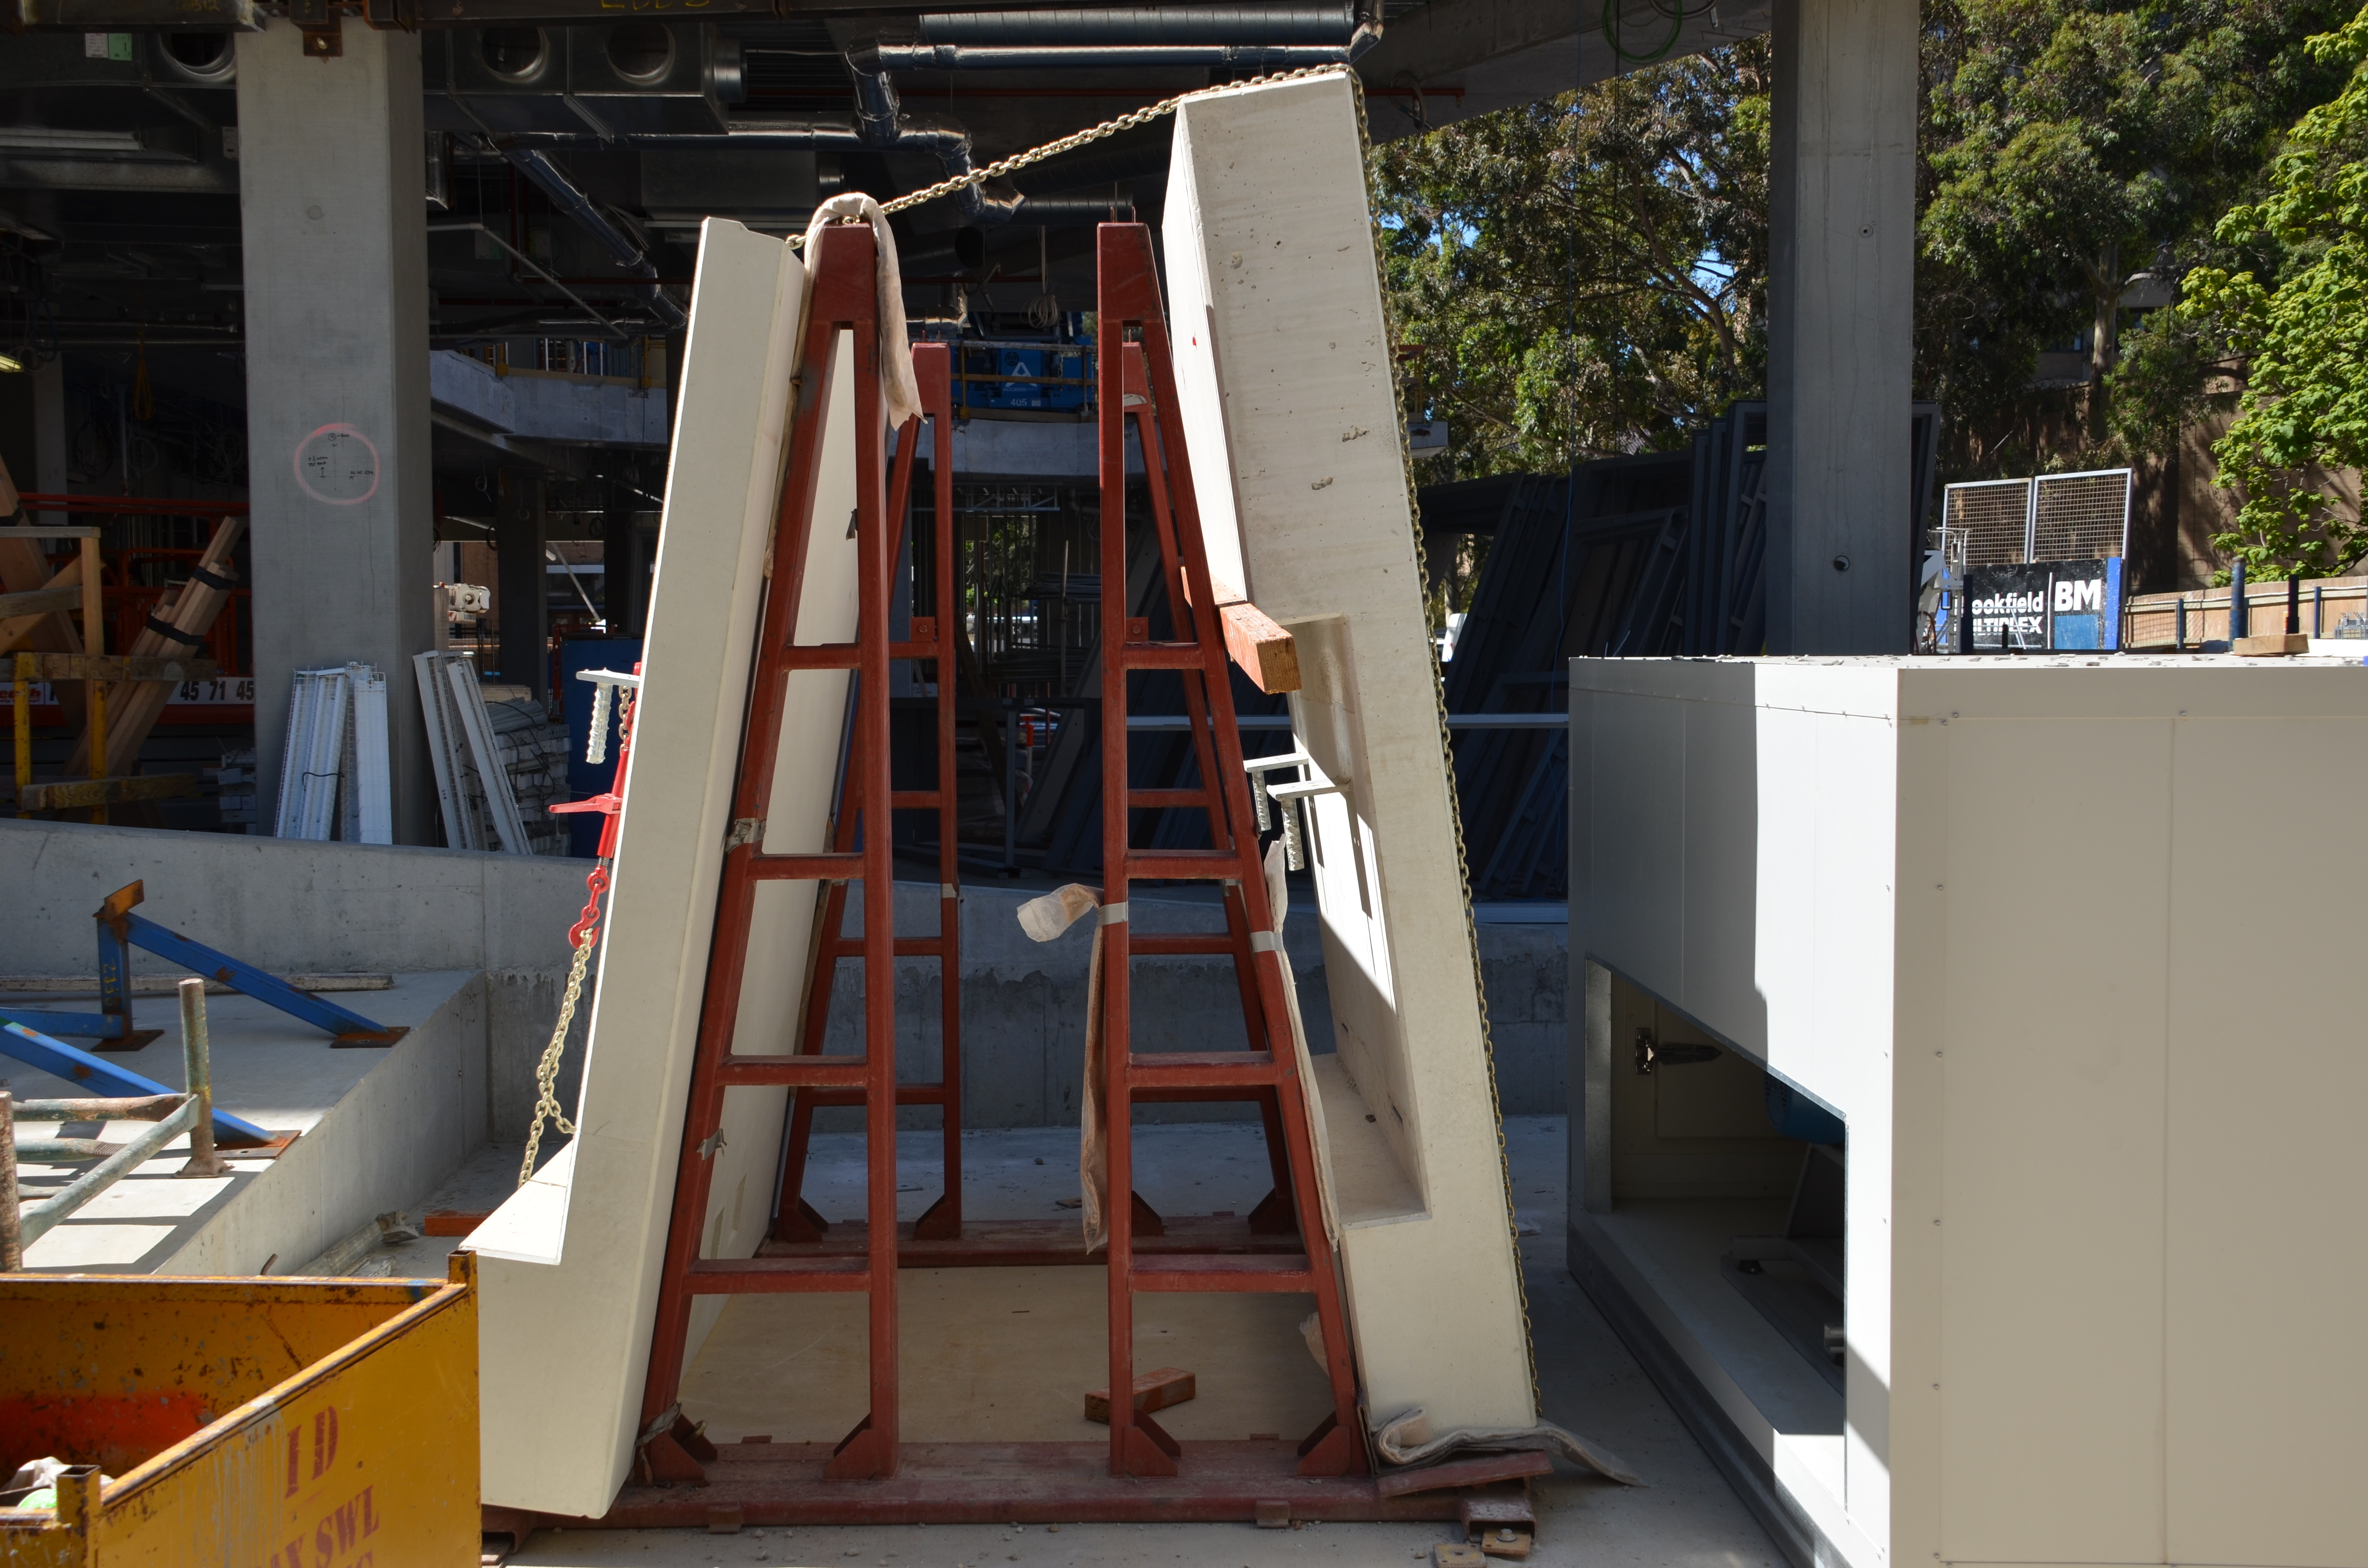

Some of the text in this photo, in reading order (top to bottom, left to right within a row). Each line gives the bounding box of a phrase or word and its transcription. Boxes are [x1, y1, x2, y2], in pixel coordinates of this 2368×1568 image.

[1954, 579, 2101, 618] ookfield BM
[1953, 616, 2043, 636] LTIPLEX
[181, 681, 254, 701] 45 71 45
